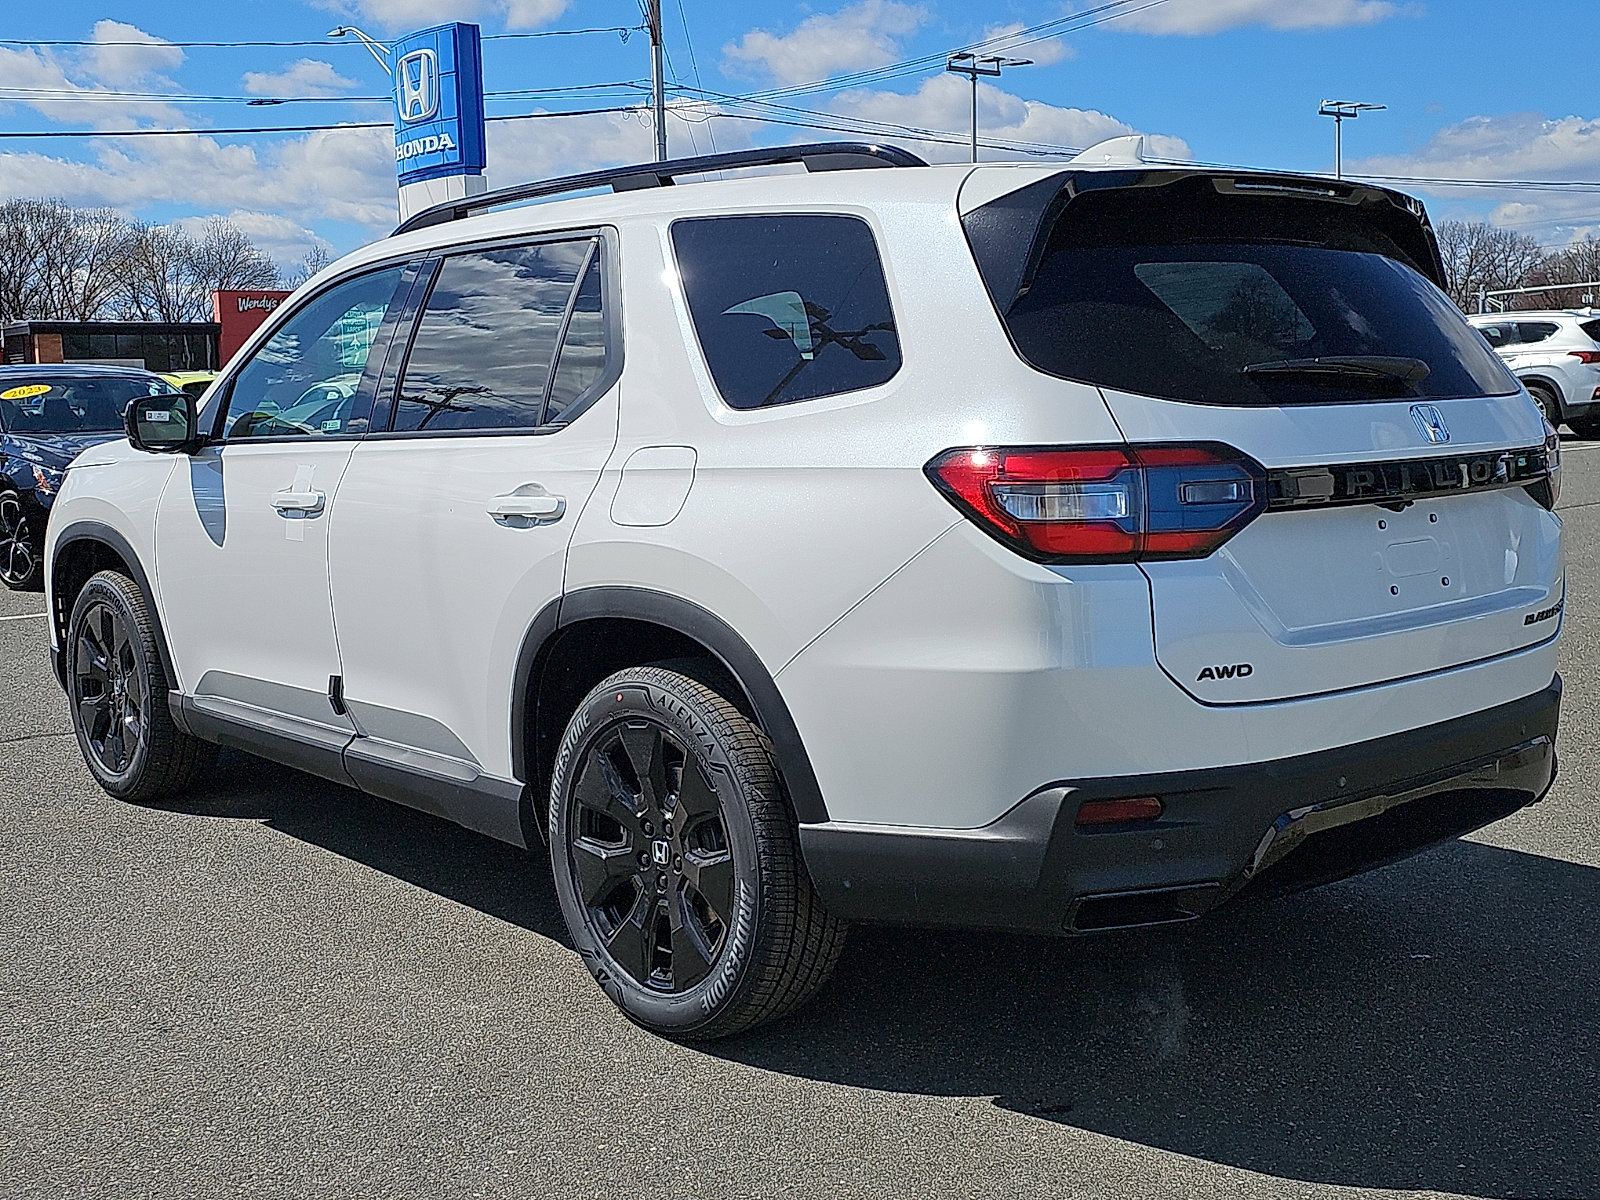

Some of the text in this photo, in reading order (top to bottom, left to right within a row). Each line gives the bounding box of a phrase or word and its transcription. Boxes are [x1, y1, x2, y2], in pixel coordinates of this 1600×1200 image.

[395, 132, 456, 161] HONDA
[237, 294, 278, 312] Wendy's
[10, 386, 42, 397] 2023
[1346, 455, 1519, 496] PILOT
[1196, 663, 1253, 682] AWD
[656, 694, 715, 756] ALENZA
[549, 704, 591, 836] BRIDGESTONE
[699, 878, 755, 1014] BRIDGESTONE
